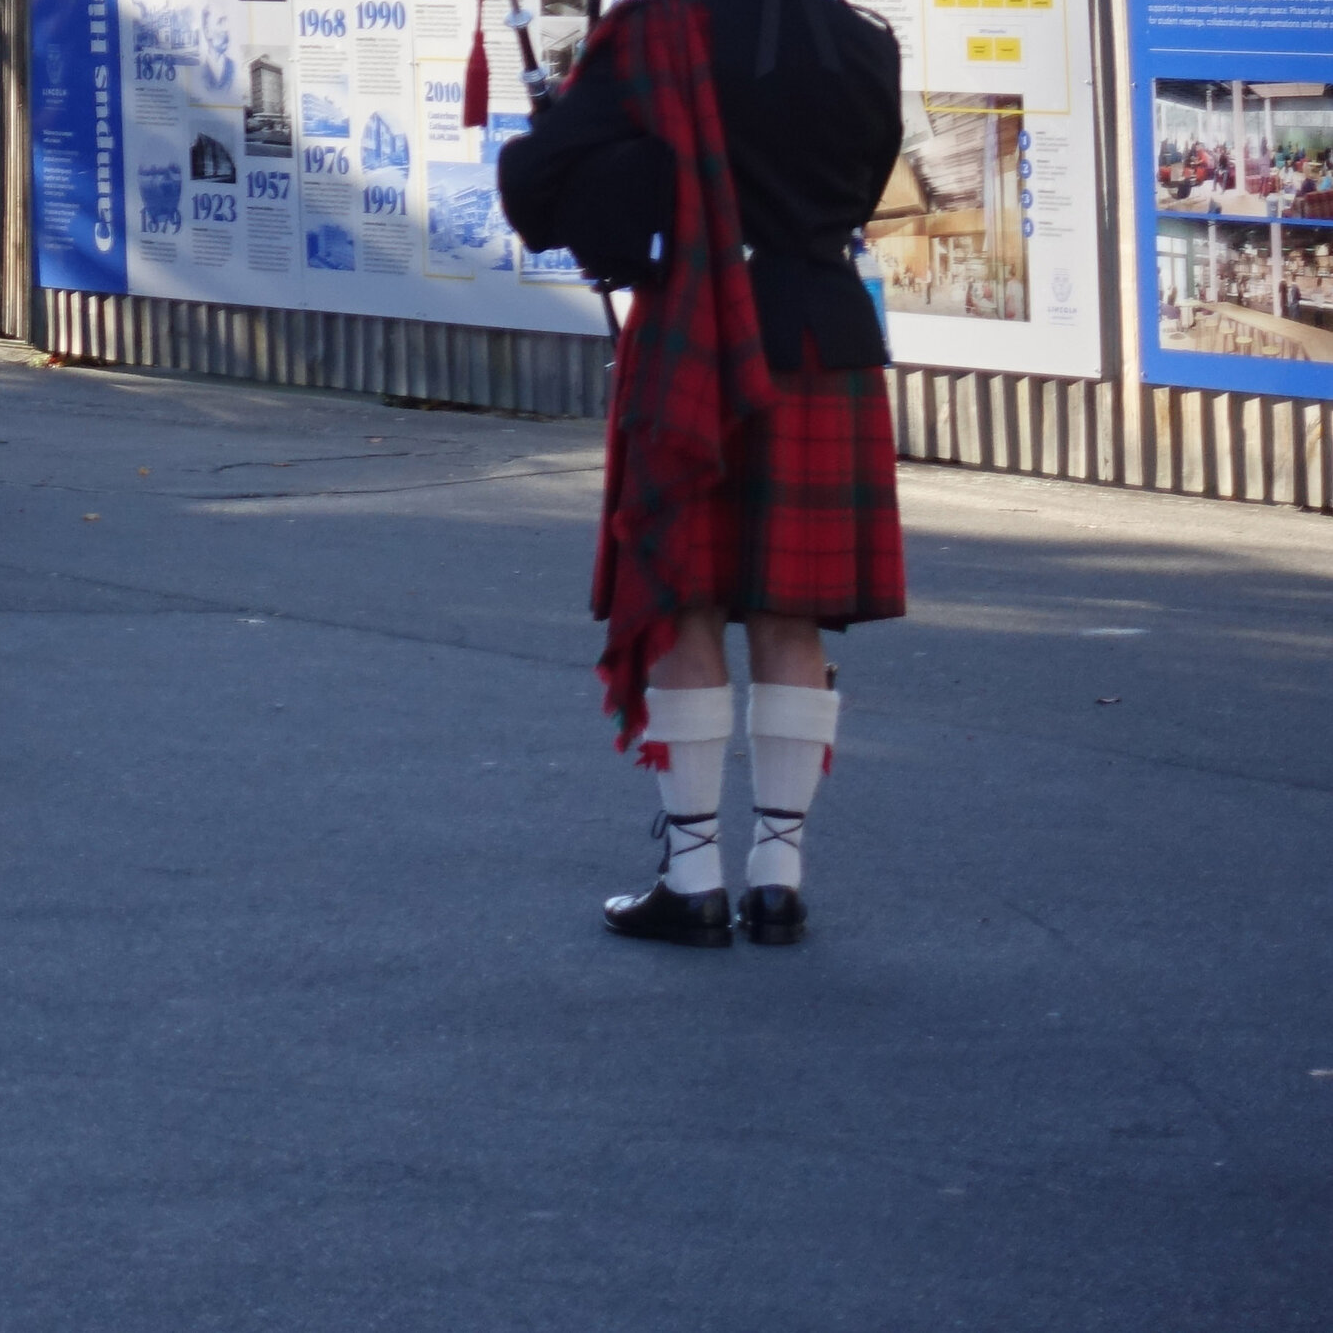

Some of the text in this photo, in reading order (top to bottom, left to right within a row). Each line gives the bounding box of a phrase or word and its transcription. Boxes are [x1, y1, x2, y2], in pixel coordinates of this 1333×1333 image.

[298, 9, 346, 37] 1968
[355, 1, 406, 30] 1990
[135, 53, 176, 82] 1878
[425, 81, 461, 103] 2010
[95, 65, 113, 252] Campus
[303, 146, 350, 175] 1976
[1022, 163, 1029, 174] 2
[246, 171, 291, 200] 1957
[192, 193, 237, 222] 1923
[363, 185, 408, 216] 1991
